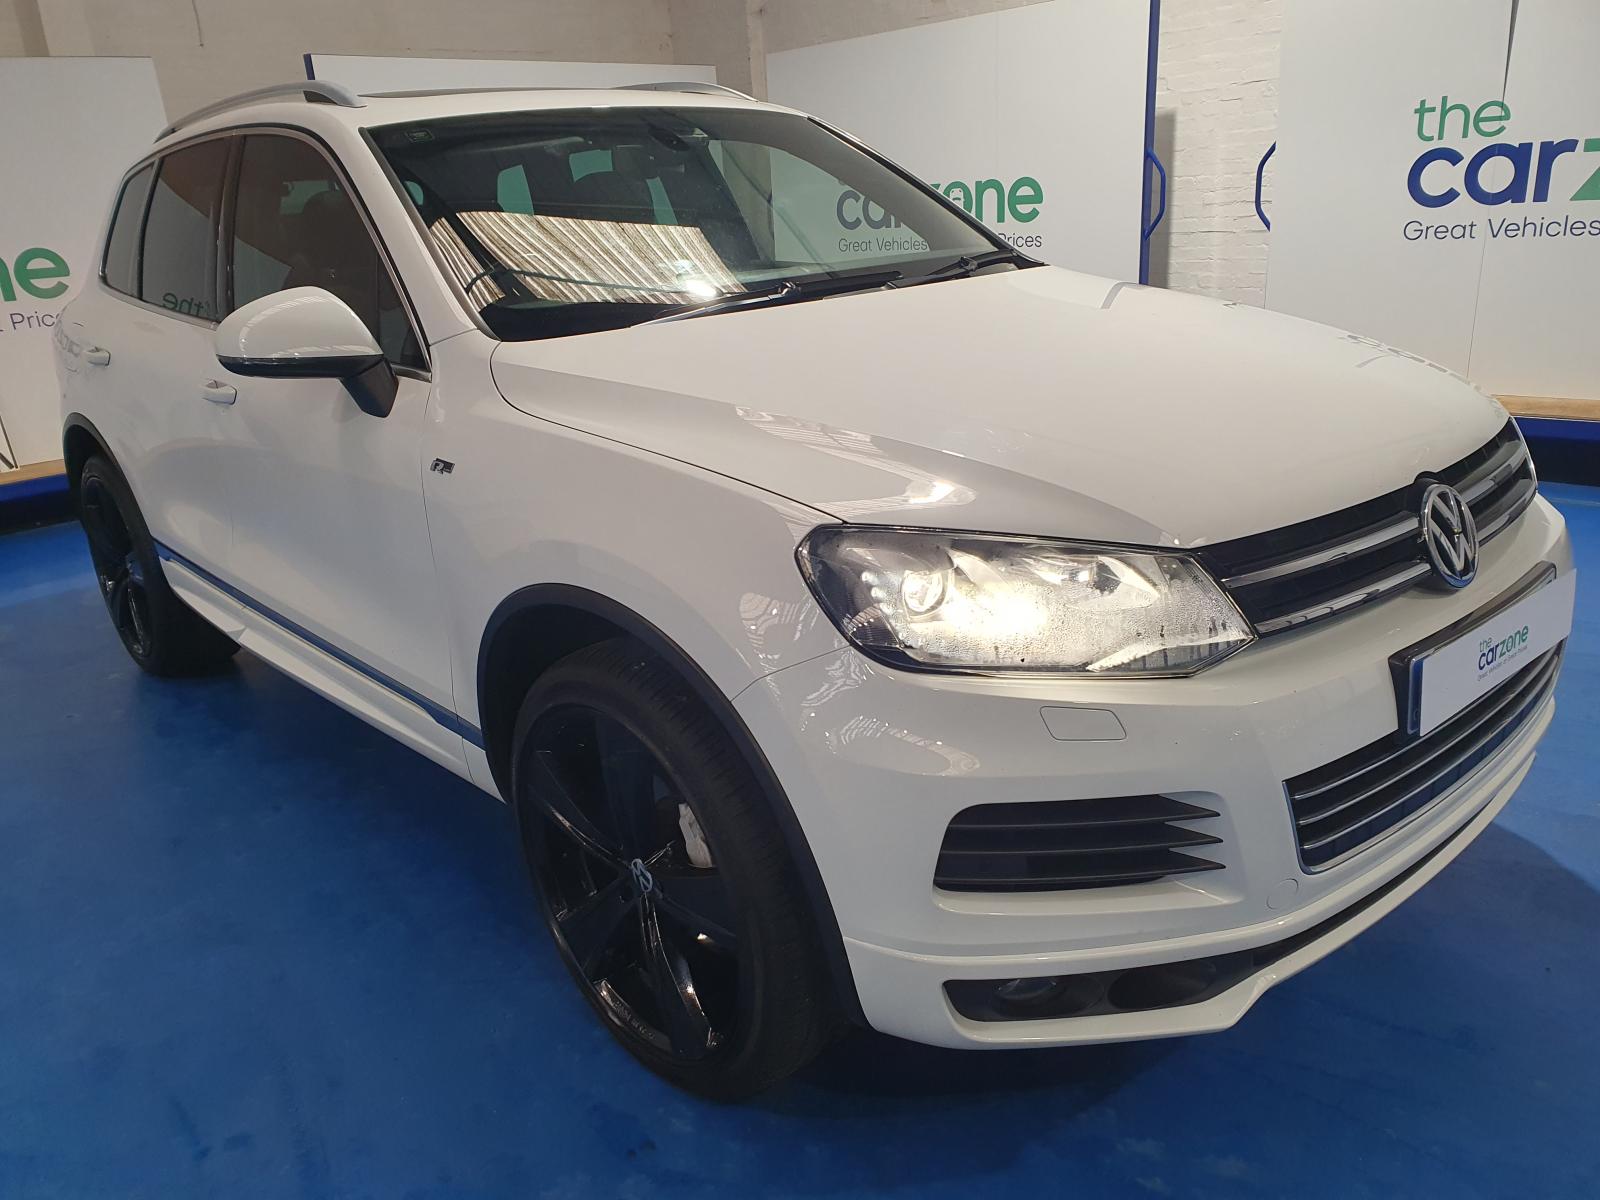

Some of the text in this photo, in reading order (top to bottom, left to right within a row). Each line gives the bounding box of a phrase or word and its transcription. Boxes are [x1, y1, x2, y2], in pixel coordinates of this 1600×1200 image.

[1414, 96, 1511, 142] the
[1403, 215, 1600, 240] Great Vehicles
[838, 236, 928, 252] Great Vehicles
[9, 311, 59, 330] Pric
[1478, 625, 1529, 670] carzone
